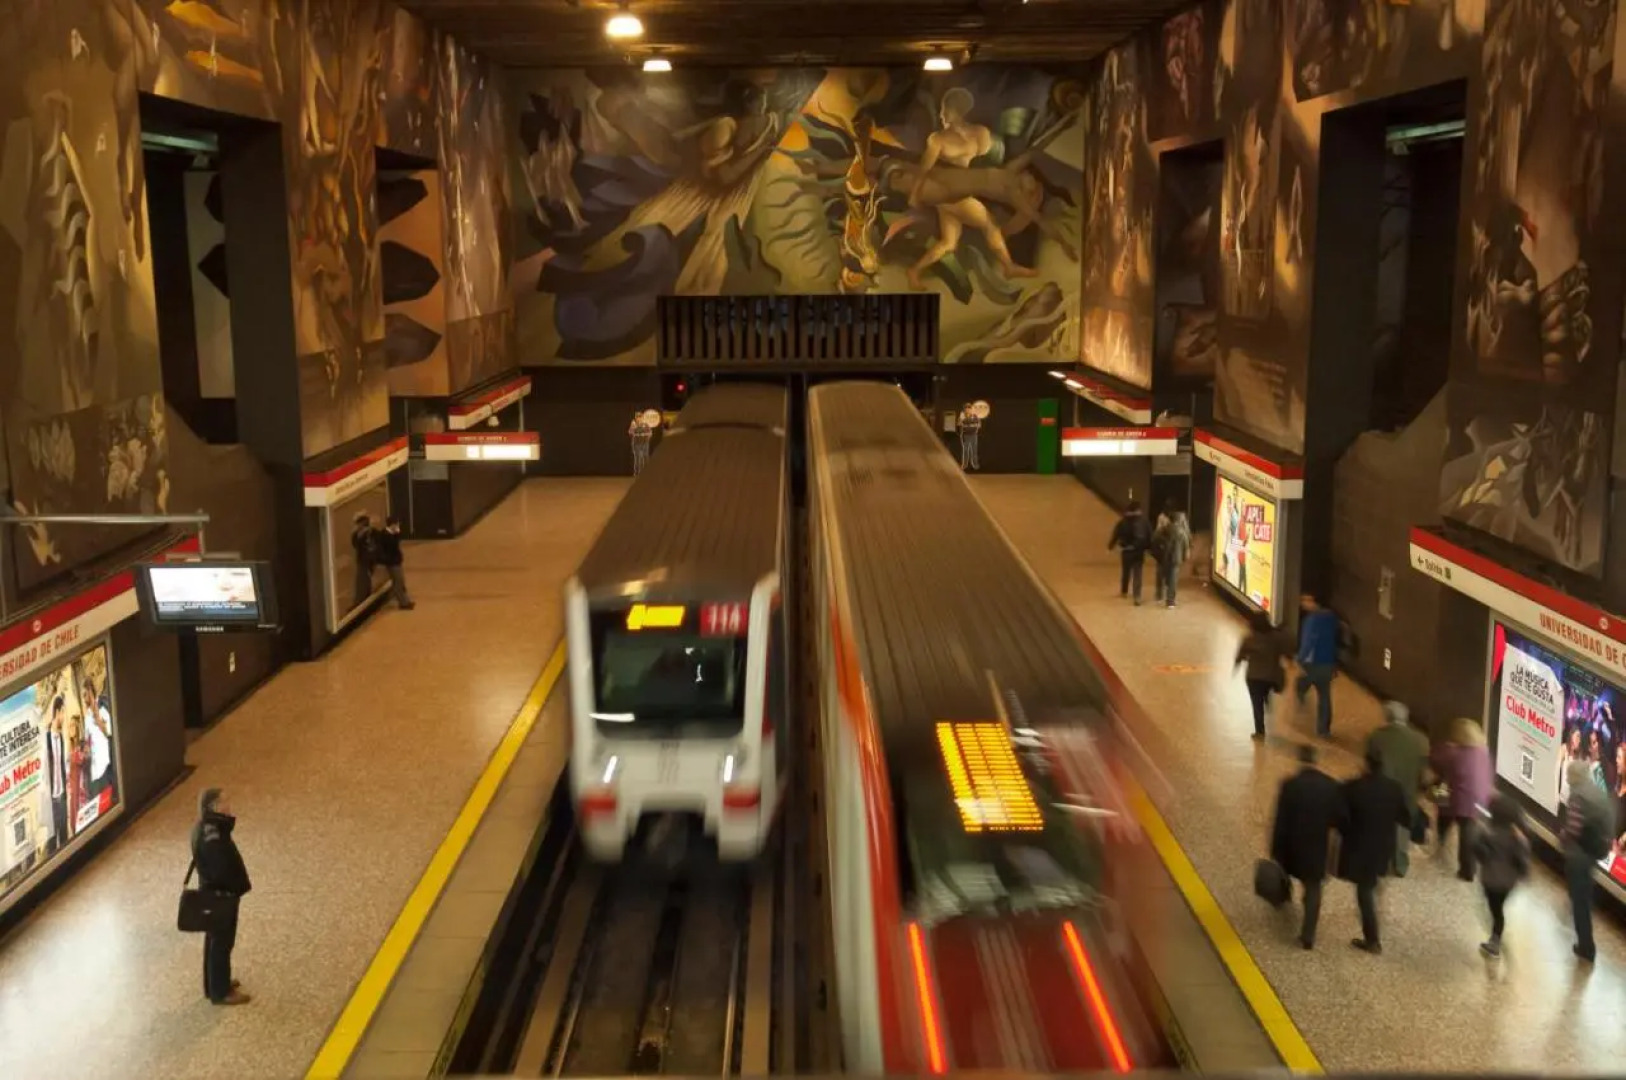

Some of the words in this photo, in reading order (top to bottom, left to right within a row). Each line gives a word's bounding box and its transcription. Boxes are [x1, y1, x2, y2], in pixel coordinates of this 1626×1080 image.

[0, 647, 38, 680] RSIDAD
[40, 639, 52, 658] DE
[55, 624, 79, 650] CHILE
[1539, 612, 1603, 656] UNIVERSIDAD
[1606, 644, 1618, 665] DE
[1516, 664, 1524, 676] LA
[1510, 671, 1524, 687] QUE
[1524, 678, 1532, 692] TE
[1533, 683, 1554, 705] GUSTA
[1506, 695, 1526, 720] Club
[1527, 707, 1556, 738] Metro
[0, 720, 30, 746] CULTURA
[9, 726, 40, 753] INTERESA
[13, 758, 41, 785] Metro
